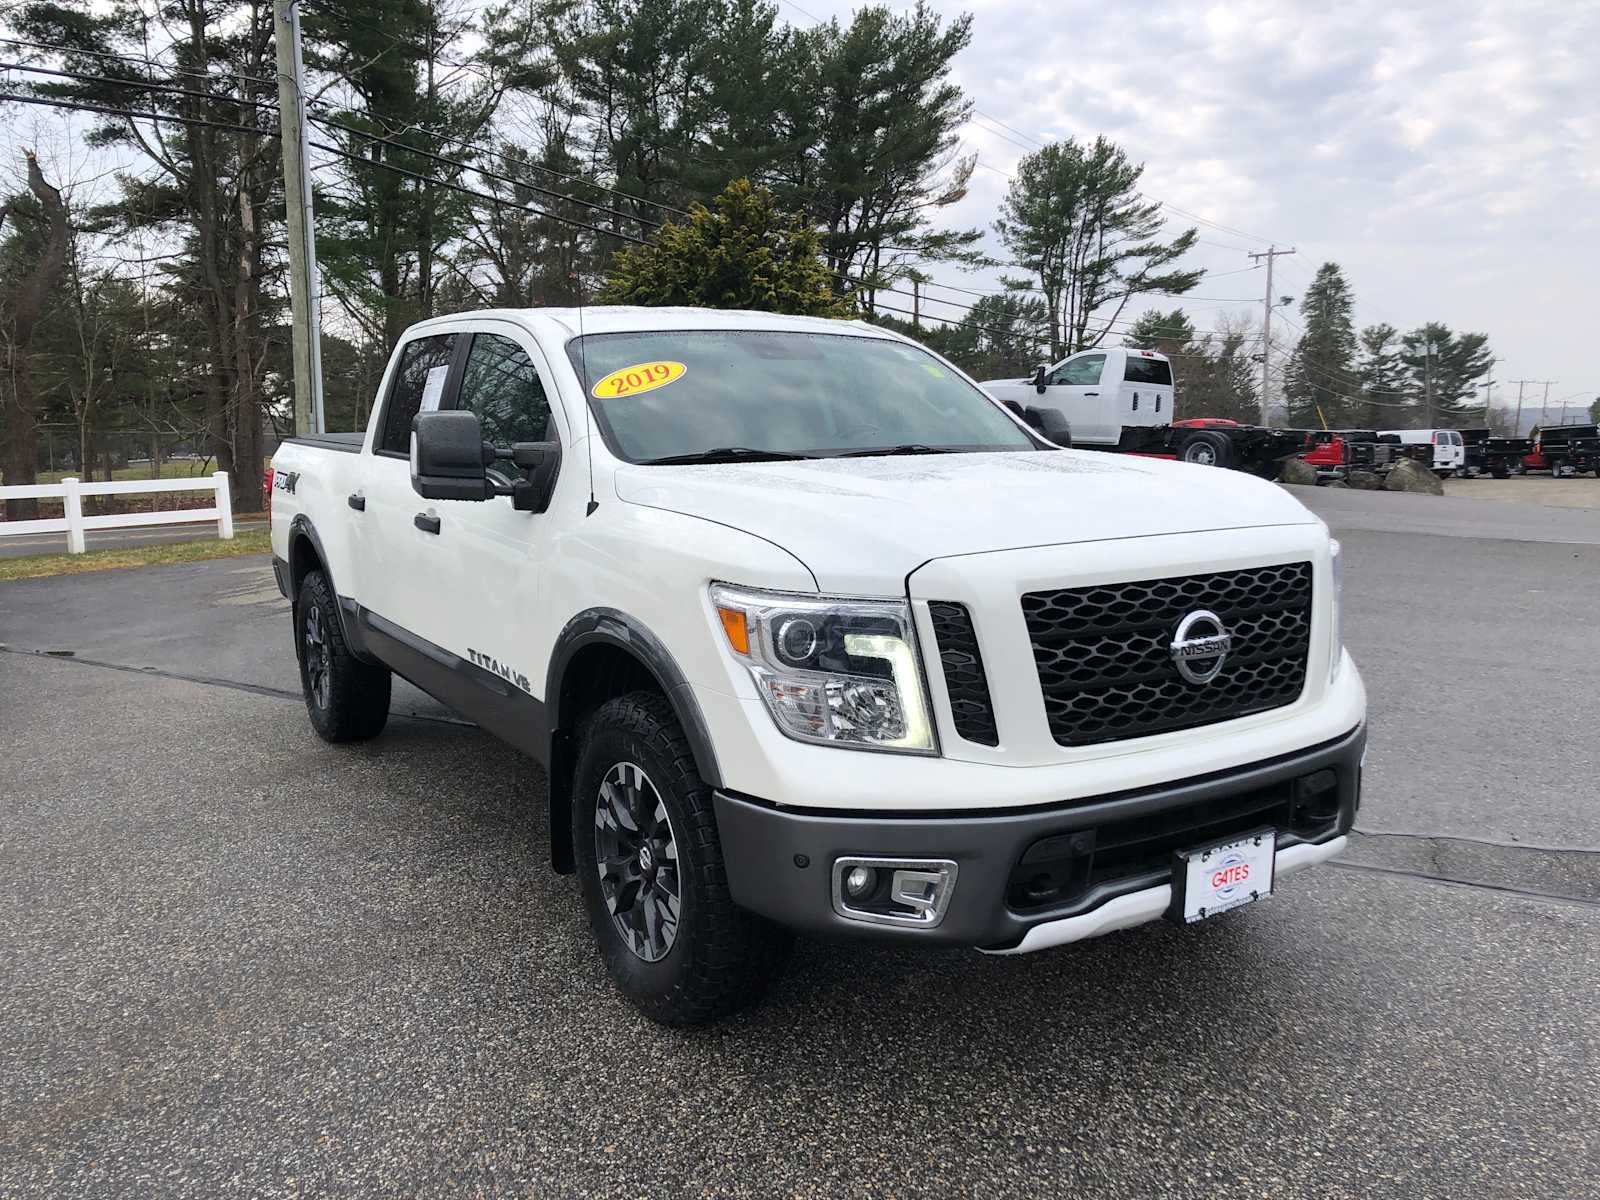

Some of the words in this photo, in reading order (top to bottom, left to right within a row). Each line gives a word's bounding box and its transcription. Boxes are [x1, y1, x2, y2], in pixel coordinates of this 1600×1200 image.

[610, 364, 670, 394] 2019
[1181, 639, 1228, 656] NISSAN
[467, 648, 510, 680] TITAN
[1212, 864, 1249, 888] GATES
